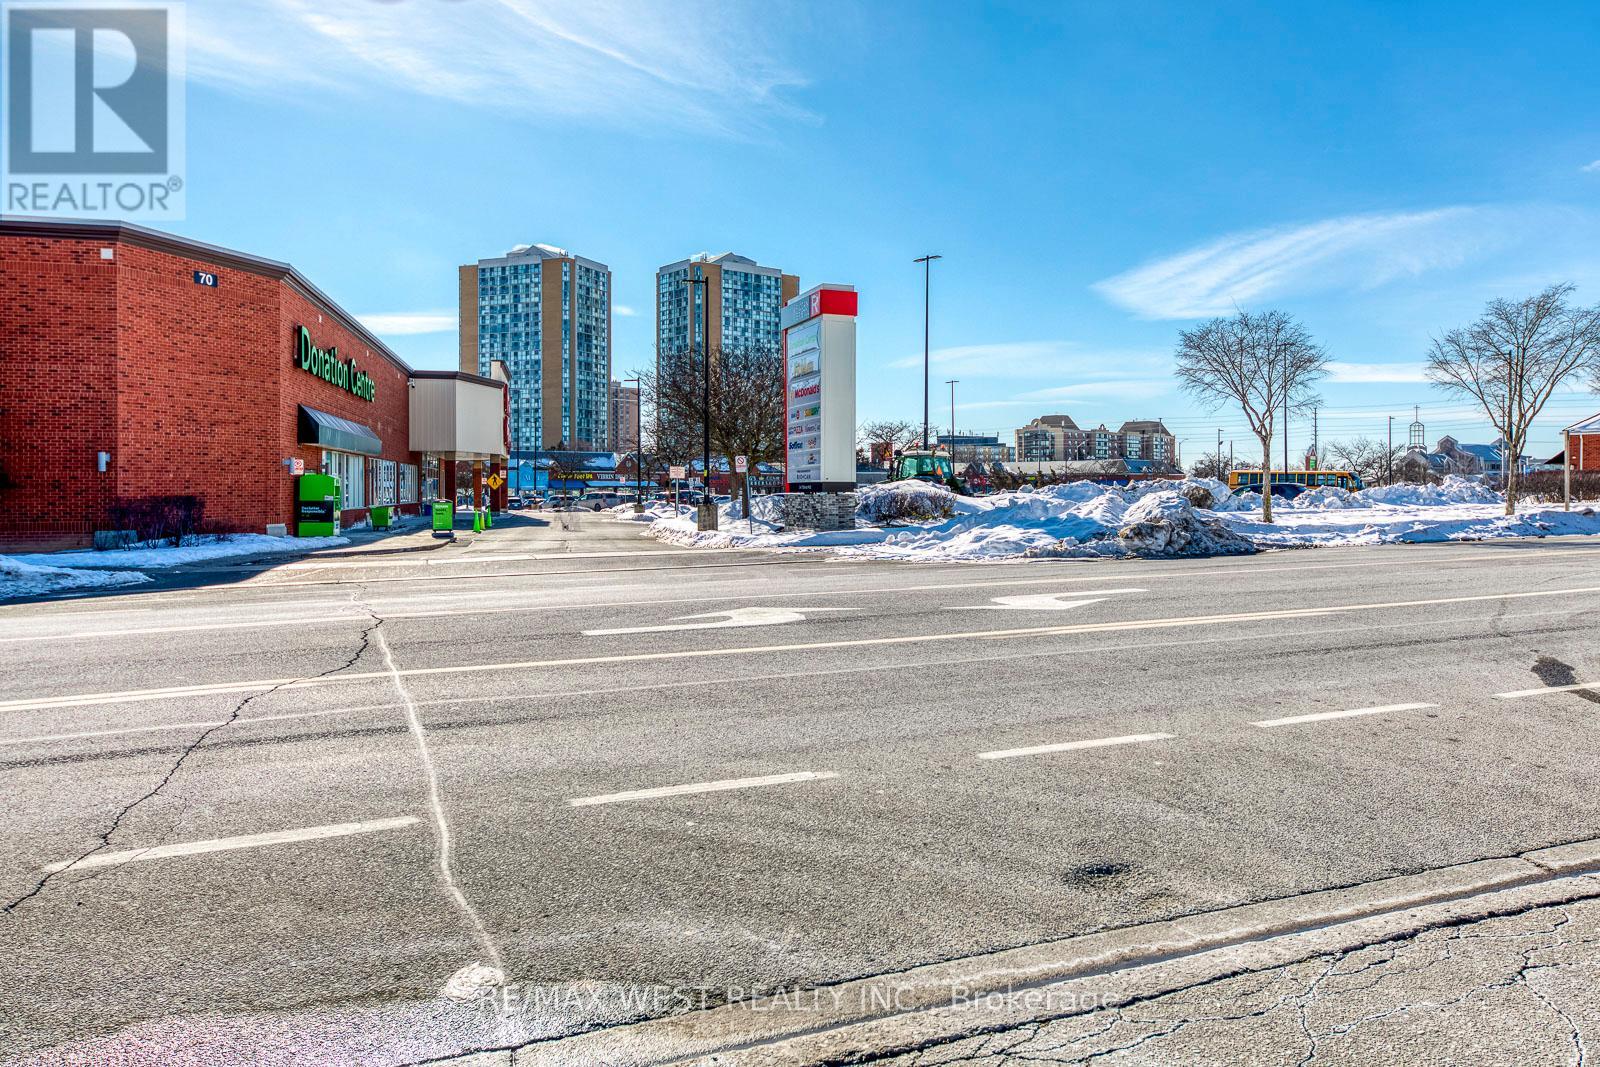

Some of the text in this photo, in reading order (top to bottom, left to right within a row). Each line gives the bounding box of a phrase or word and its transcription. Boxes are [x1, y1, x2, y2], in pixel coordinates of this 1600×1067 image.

[198, 272, 213, 286] 70
[300, 325, 376, 402] Donation Centre
[795, 384, 820, 398] McDonald's
